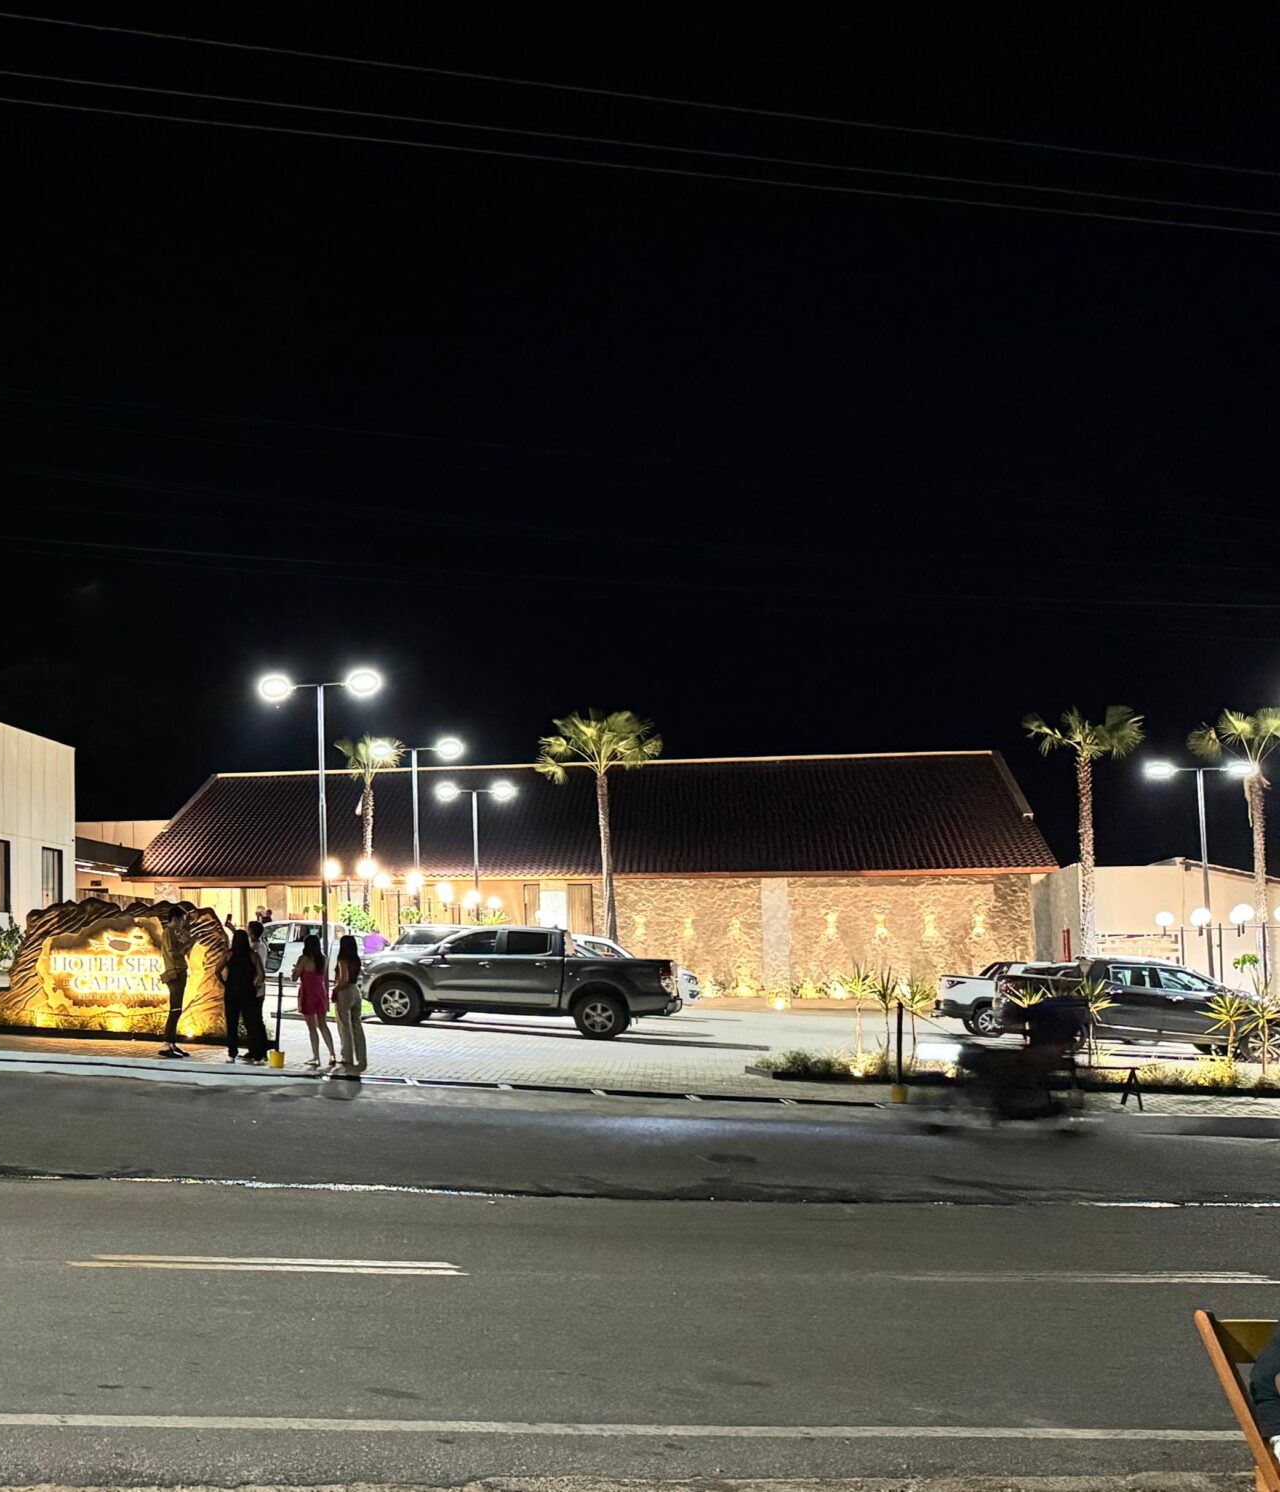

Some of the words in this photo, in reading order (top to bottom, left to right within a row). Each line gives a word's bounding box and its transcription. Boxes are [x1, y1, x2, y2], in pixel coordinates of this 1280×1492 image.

[52, 956, 121, 972] HOTEL
[125, 956, 161, 973] SER
[74, 975, 162, 992] CAPIVAR
